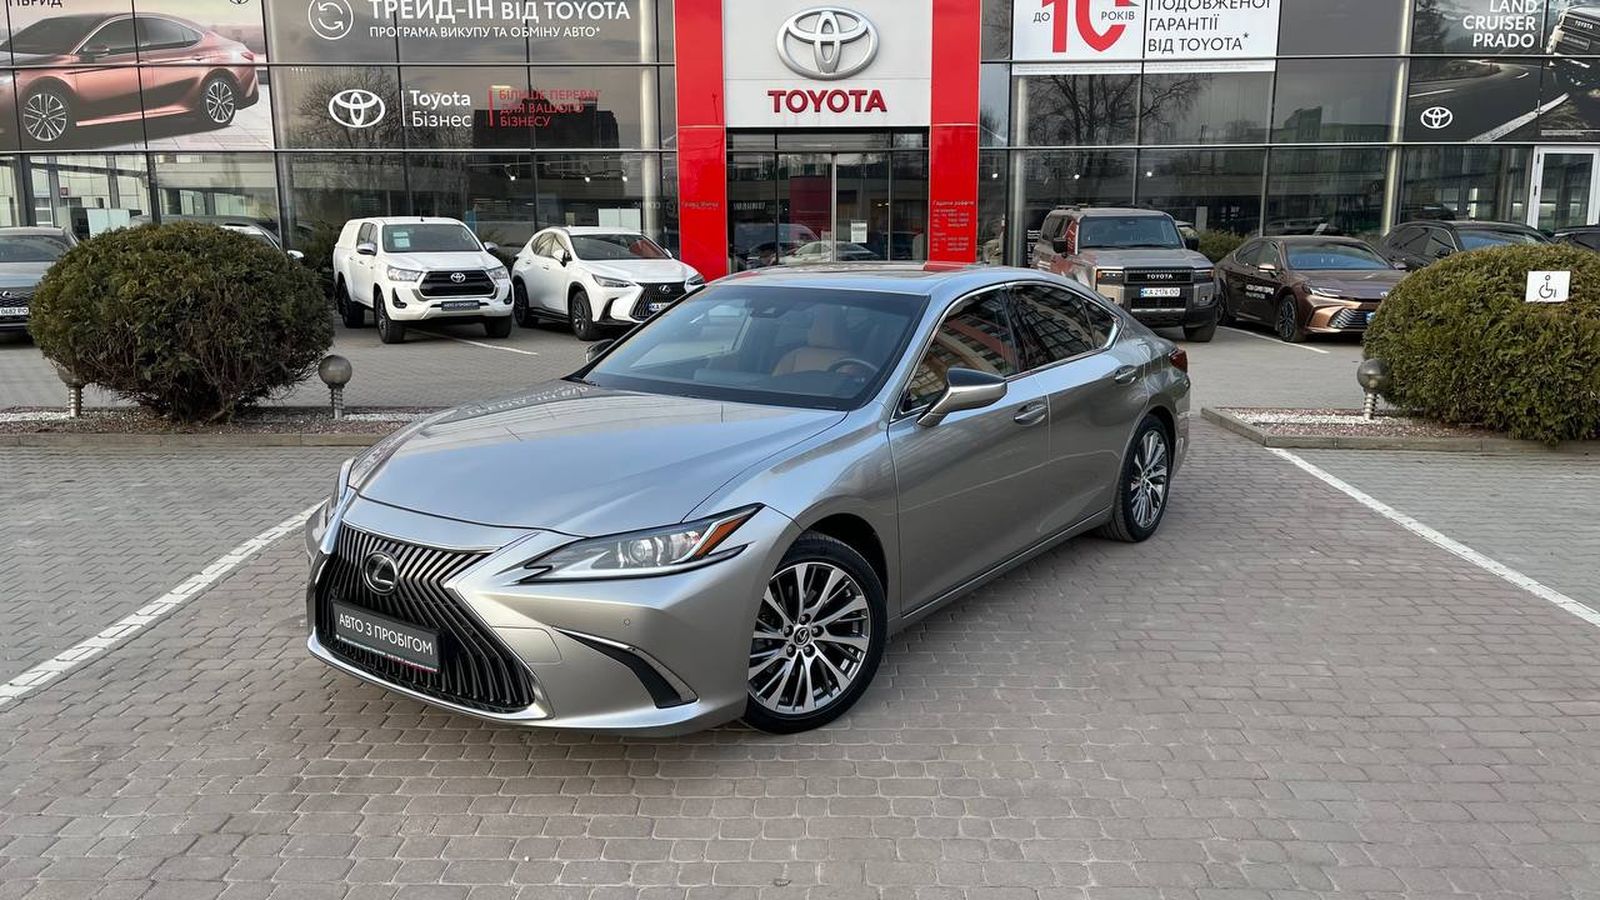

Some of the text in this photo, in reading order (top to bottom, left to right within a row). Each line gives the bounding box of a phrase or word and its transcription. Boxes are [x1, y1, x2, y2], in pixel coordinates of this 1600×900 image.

[369, 0, 631, 24] ТРЕЙД-ІН ВІД TOYOTA
[1490, 0, 1538, 13] LAND
[1033, 12, 1051, 23] ДО
[1101, 11, 1135, 20] РОКІВ
[1149, 14, 1219, 31] ГАРАНТІЇ
[1463, 15, 1536, 30] CRUISER
[369, 26, 438, 37] ПРОГРАМА
[440, 26, 491, 37] ВИКУПУ
[493, 26, 508, 37] ТА
[510, 26, 560, 37] ОБМІНУ
[1148, 38, 1174, 54] ВІД
[1473, 32, 1535, 48] PRADO
[409, 89, 472, 110] Toyota
[767, 89, 888, 113] TOYOTA
[412, 110, 472, 127] Бізнес
[500, 116, 551, 127] БІЗНЕСУ
[339, 613, 432, 655] АВТО З ПРОБІГОМ
